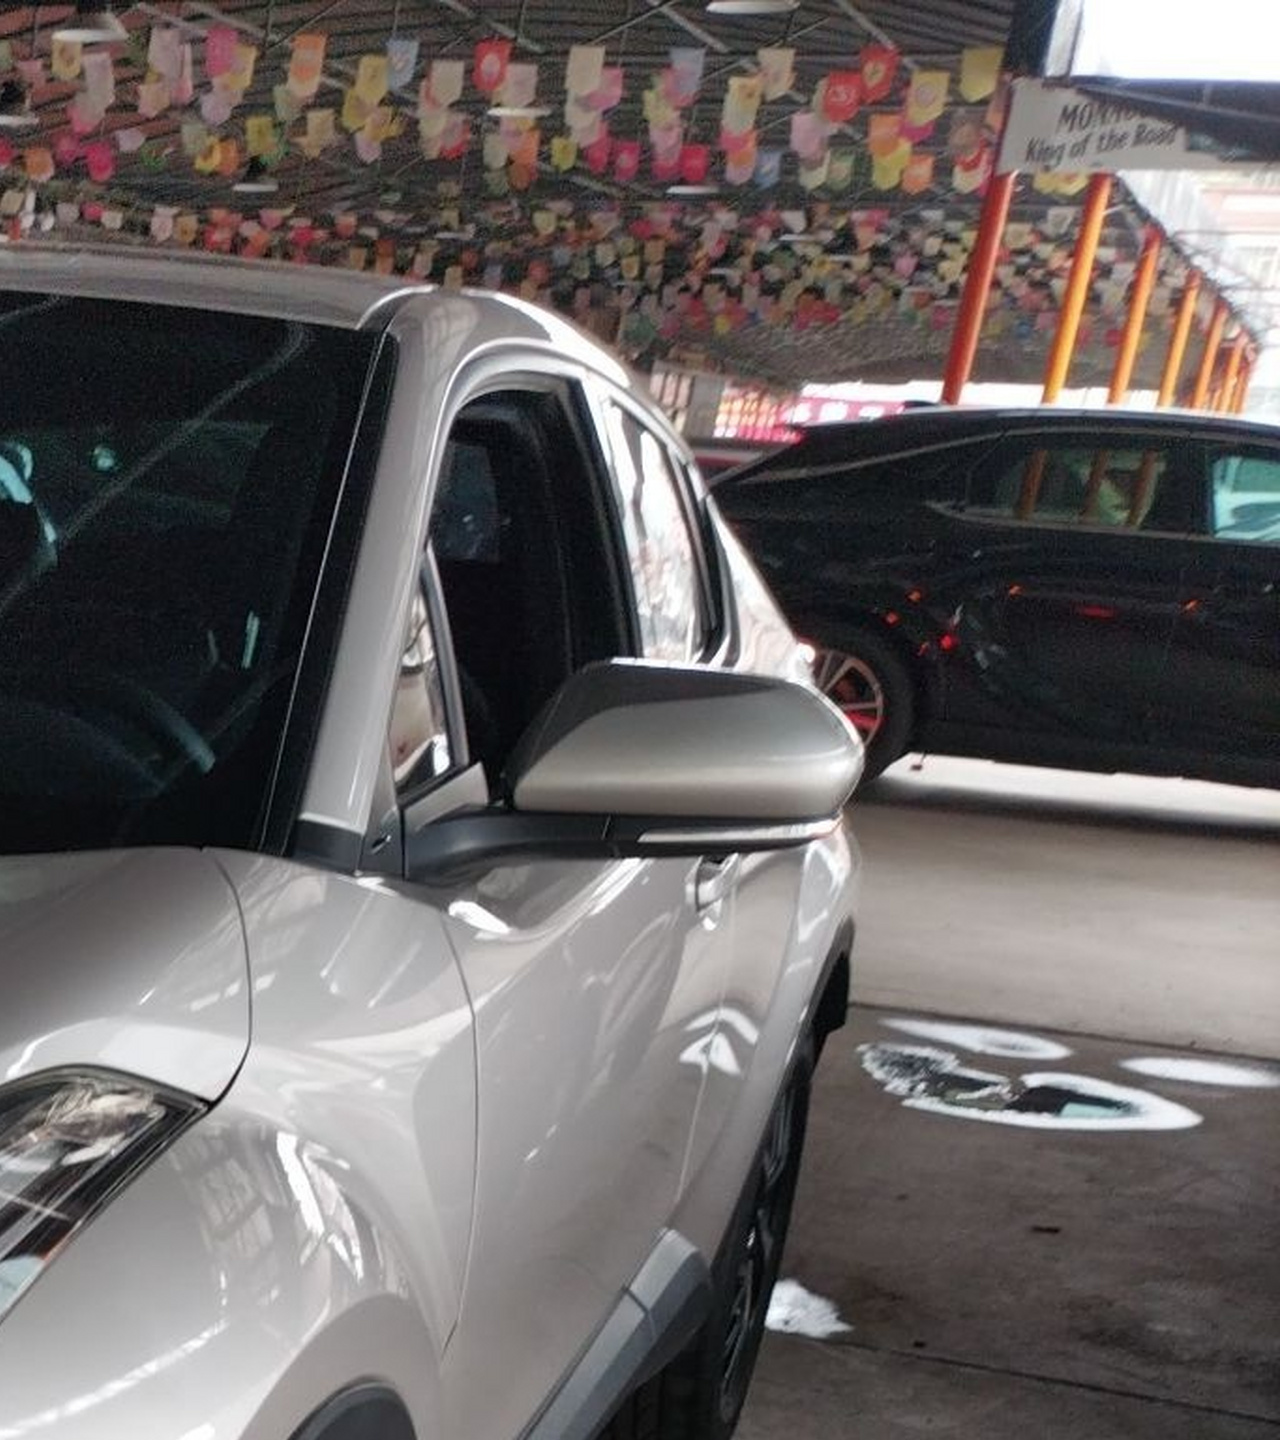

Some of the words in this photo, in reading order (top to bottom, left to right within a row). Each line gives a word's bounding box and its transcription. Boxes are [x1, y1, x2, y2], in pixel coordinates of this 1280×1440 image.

[1026, 137, 1066, 166] King
[1069, 134, 1092, 159] of
[1097, 128, 1129, 153] the
